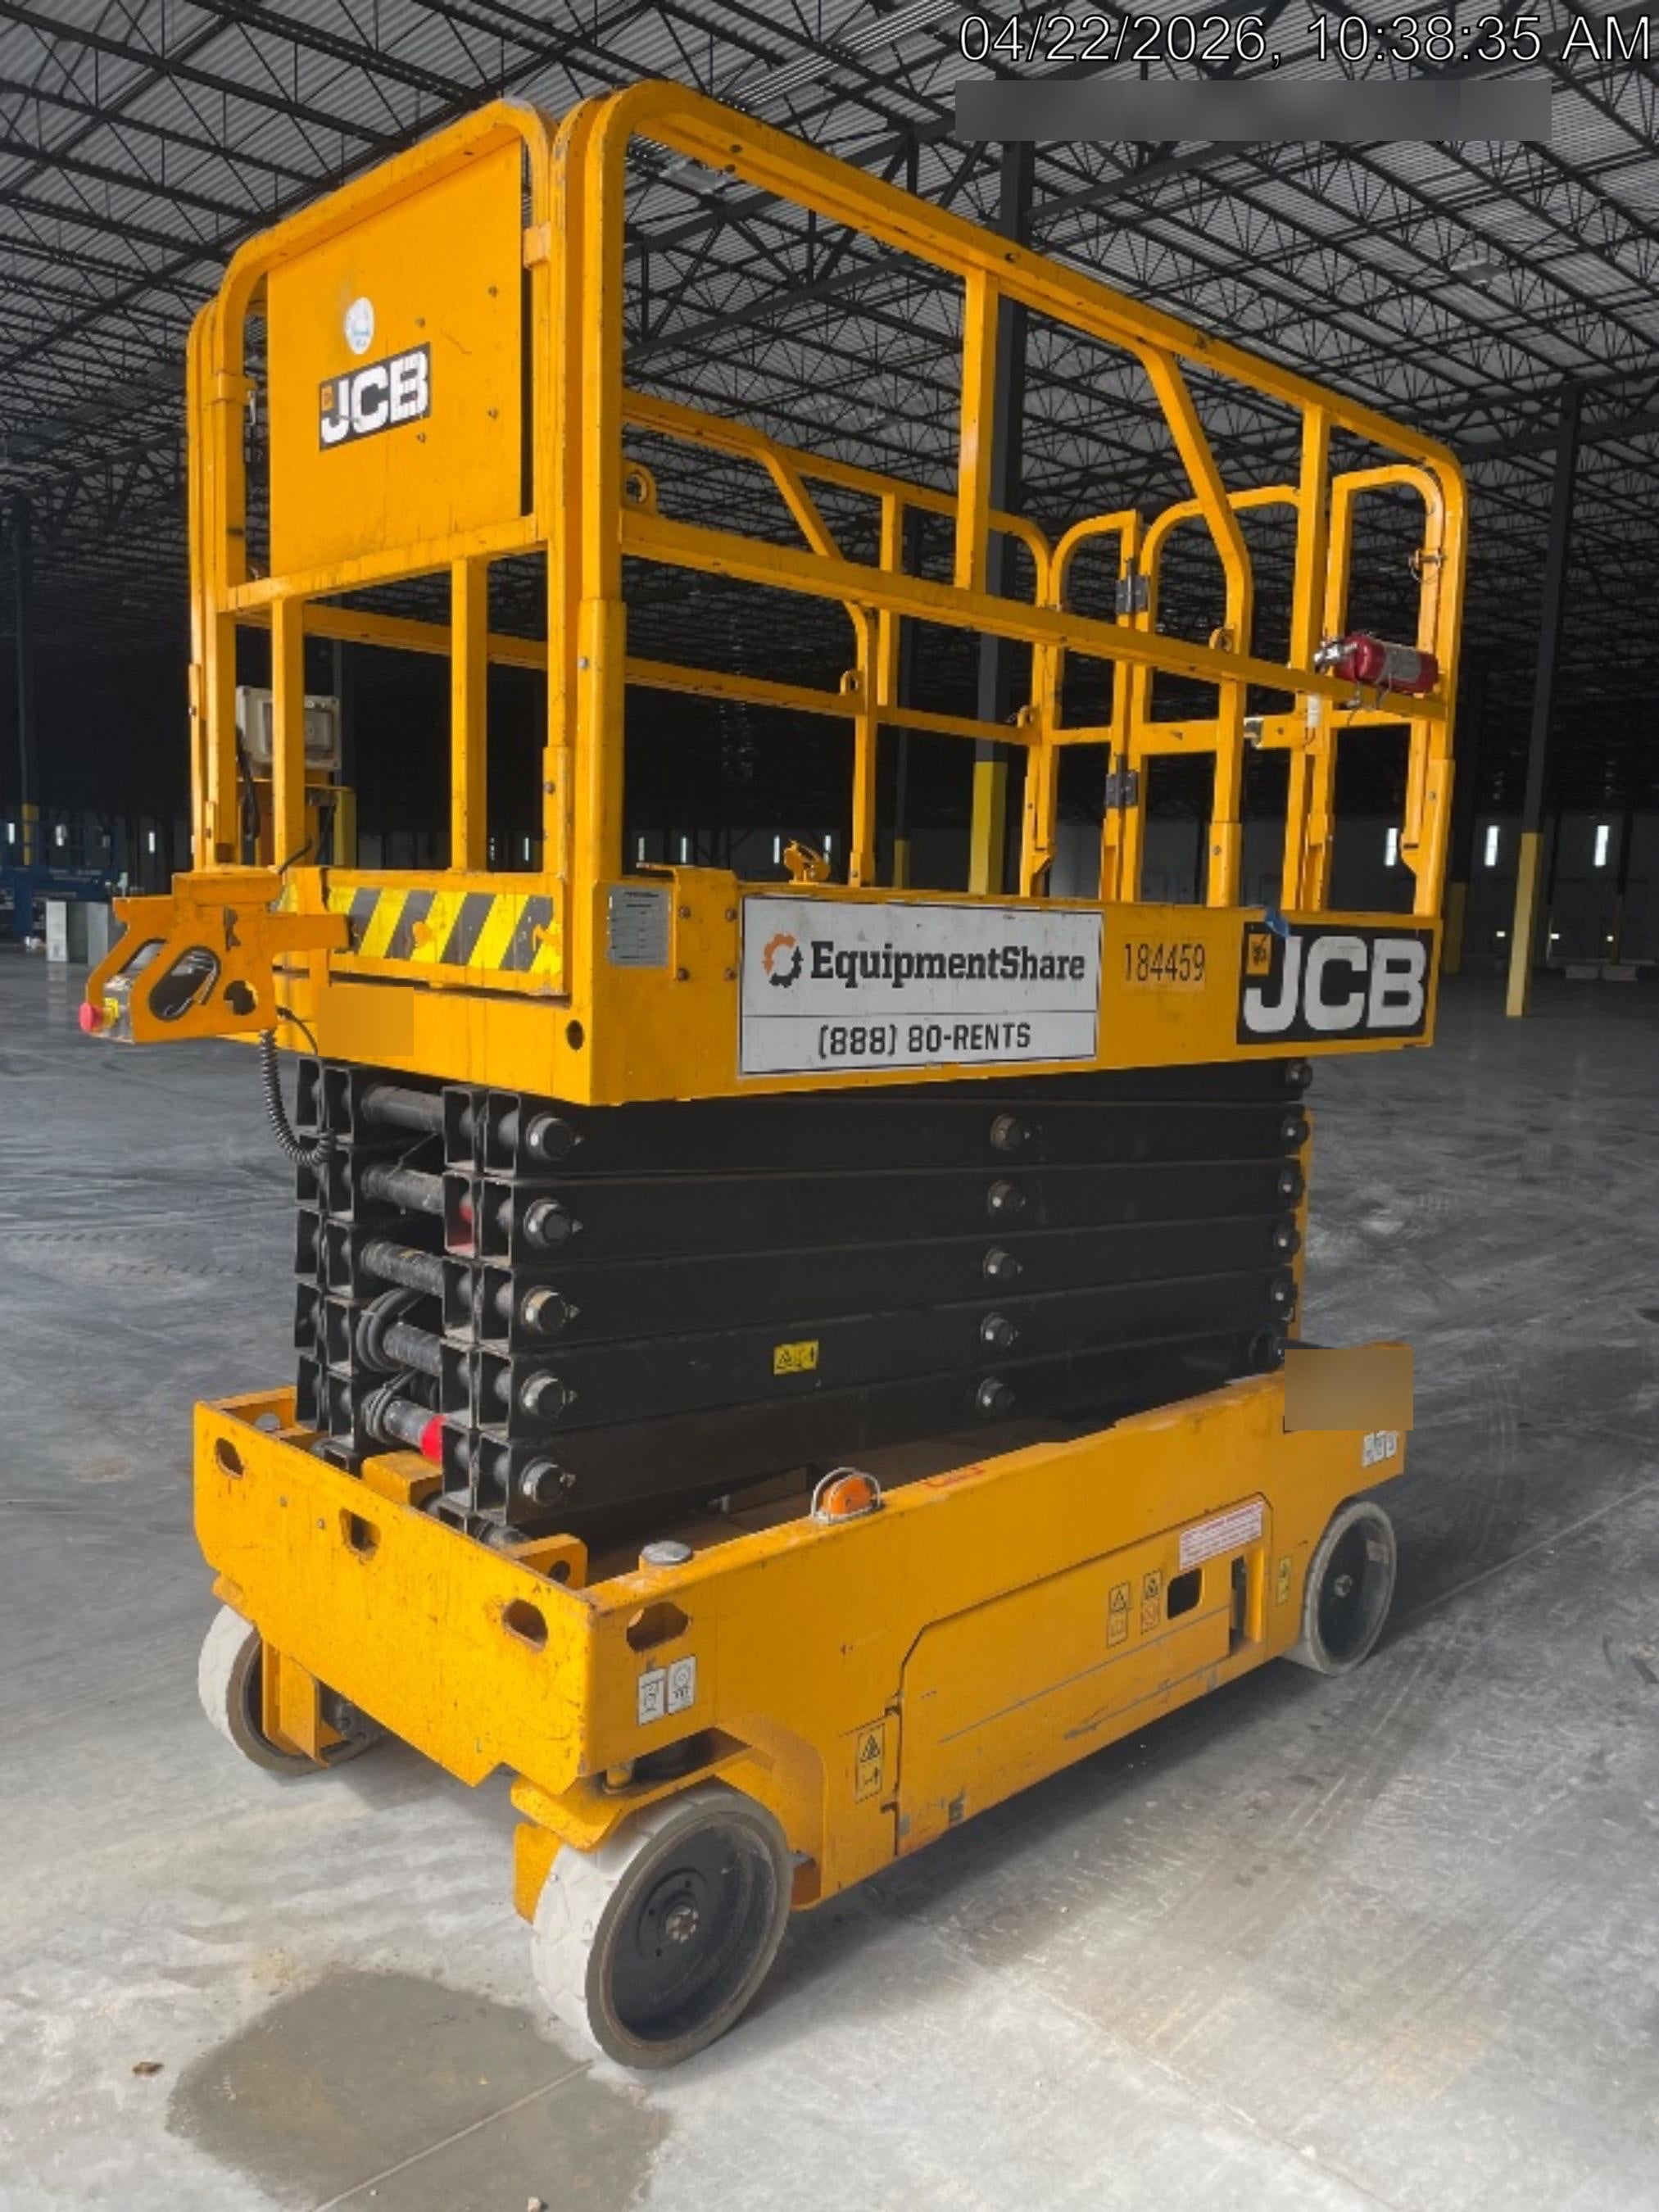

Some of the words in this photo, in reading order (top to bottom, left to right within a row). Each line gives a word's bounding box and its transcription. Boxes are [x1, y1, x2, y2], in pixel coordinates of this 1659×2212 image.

[320, 351, 428, 443] JCB
[809, 940, 1086, 989] EquipmentShare
[1125, 943, 1206, 981] 184459
[1242, 935, 1427, 1033] JCB
[818, 1024, 897, 1059] (888)
[908, 1022, 1031, 1054] 80-RENTS
